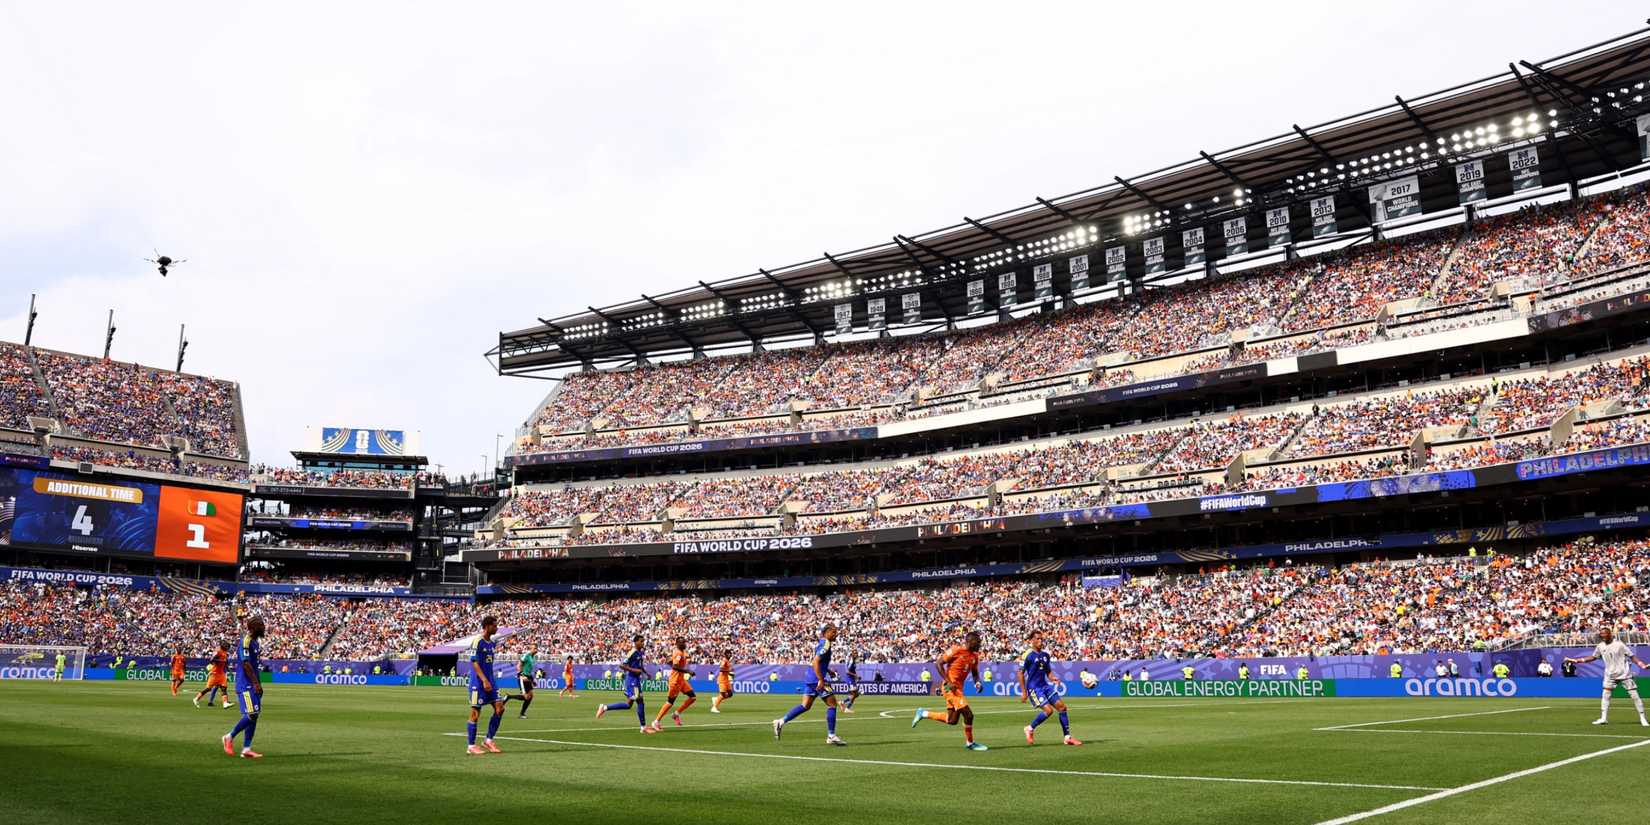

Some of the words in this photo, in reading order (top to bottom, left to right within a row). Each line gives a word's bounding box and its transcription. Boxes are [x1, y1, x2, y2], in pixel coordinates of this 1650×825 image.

[1512, 156, 1536, 169] 2022
[1460, 169, 1481, 181] 2019
[1391, 184, 1411, 196] 2017
[1387, 200, 1419, 212] CHAMPIONS
[1392, 196, 1412, 205] WORLD
[1314, 205, 1333, 216] 2013
[1269, 215, 1287, 226] 2010
[1226, 226, 1244, 237] 2006
[1185, 236, 1203, 247] 2004
[1145, 246, 1163, 256] 2003
[1107, 254, 1124, 264] 2002
[1072, 263, 1087, 273] 2001
[628, 448, 642, 456] FIFA
[642, 446, 666, 455] WORLD
[666, 445, 679, 453] CUP
[679, 443, 703, 451] 2026
[47, 481, 109, 498] ADDITIONAL
[110, 487, 135, 500] TIME
[1200, 495, 1266, 510] #FIFAWorldCup
[71, 505, 94, 535] 4
[186, 523, 210, 549] 1
[72, 544, 98, 552] Hisense
[673, 542, 699, 553] FIFA
[699, 540, 743, 552] WORLD
[743, 539, 768, 550] CUP
[768, 537, 812, 549] 2026
[1285, 540, 1382, 552] PHILADELPH
[498, 548, 569, 560] PHILADELPHIA
[1096, 557, 1119, 566] WORLD
[1134, 554, 1158, 562] 2026
[11, 570, 36, 580] FIFA
[36, 571, 76, 582] WORLD
[76, 574, 97, 584] CUP
[98, 575, 133, 585] 2026
[911, 568, 977, 578] PHILADELPHIA
[313, 585, 395, 594] PHILADELPHIA
[126, 669, 167, 681] GLOBAL
[1260, 664, 1287, 675] FIFA
[315, 673, 367, 685] aramco
[441, 675, 469, 686] aramc
[533, 677, 559, 688] amco
[587, 679, 614, 690] GLOBAL
[731, 680, 770, 693] amco
[878, 683, 889, 693] OF
[890, 683, 928, 693] AMERICA
[1127, 680, 1182, 697] GLOBAL
[1185, 680, 1244, 697] ENERGY
[1405, 678, 1517, 697] aramco
